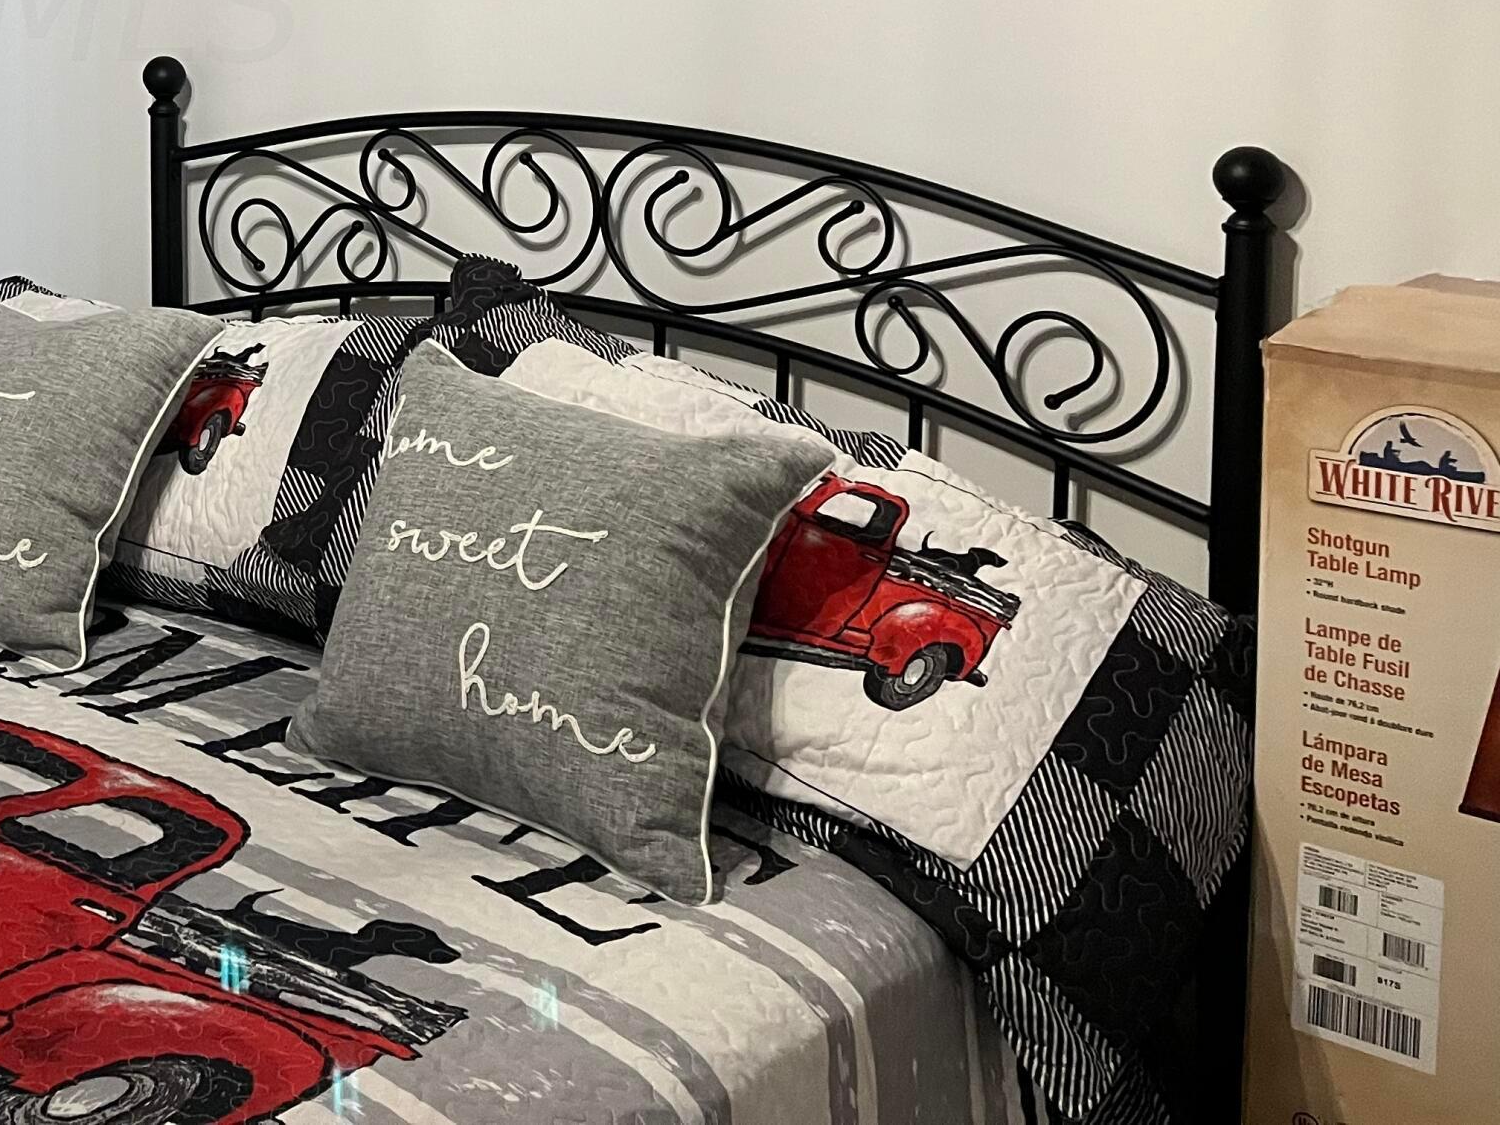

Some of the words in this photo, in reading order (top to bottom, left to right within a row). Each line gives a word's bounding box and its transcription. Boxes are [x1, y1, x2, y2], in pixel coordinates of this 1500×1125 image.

[1318, 458, 1418, 506] WHITE
[387, 509, 609, 591] sweet
[1307, 526, 1391, 558] Shotgun
[1307, 549, 1359, 576] Table
[1365, 560, 1421, 590] Lamp
[1305, 617, 1371, 647] Lampe
[1378, 634, 1402, 653] de
[1304, 640, 1356, 667] Table
[1363, 653, 1410, 679] Fusil
[458, 621, 656, 763] home
[1304, 665, 1327, 683] de
[1334, 670, 1405, 701] Chasse
[1302, 730, 1388, 766] Lámpara
[1301, 754, 1324, 773] de
[1331, 760, 1383, 788] Mesa
[1300, 775, 1401, 816] Escopetas
